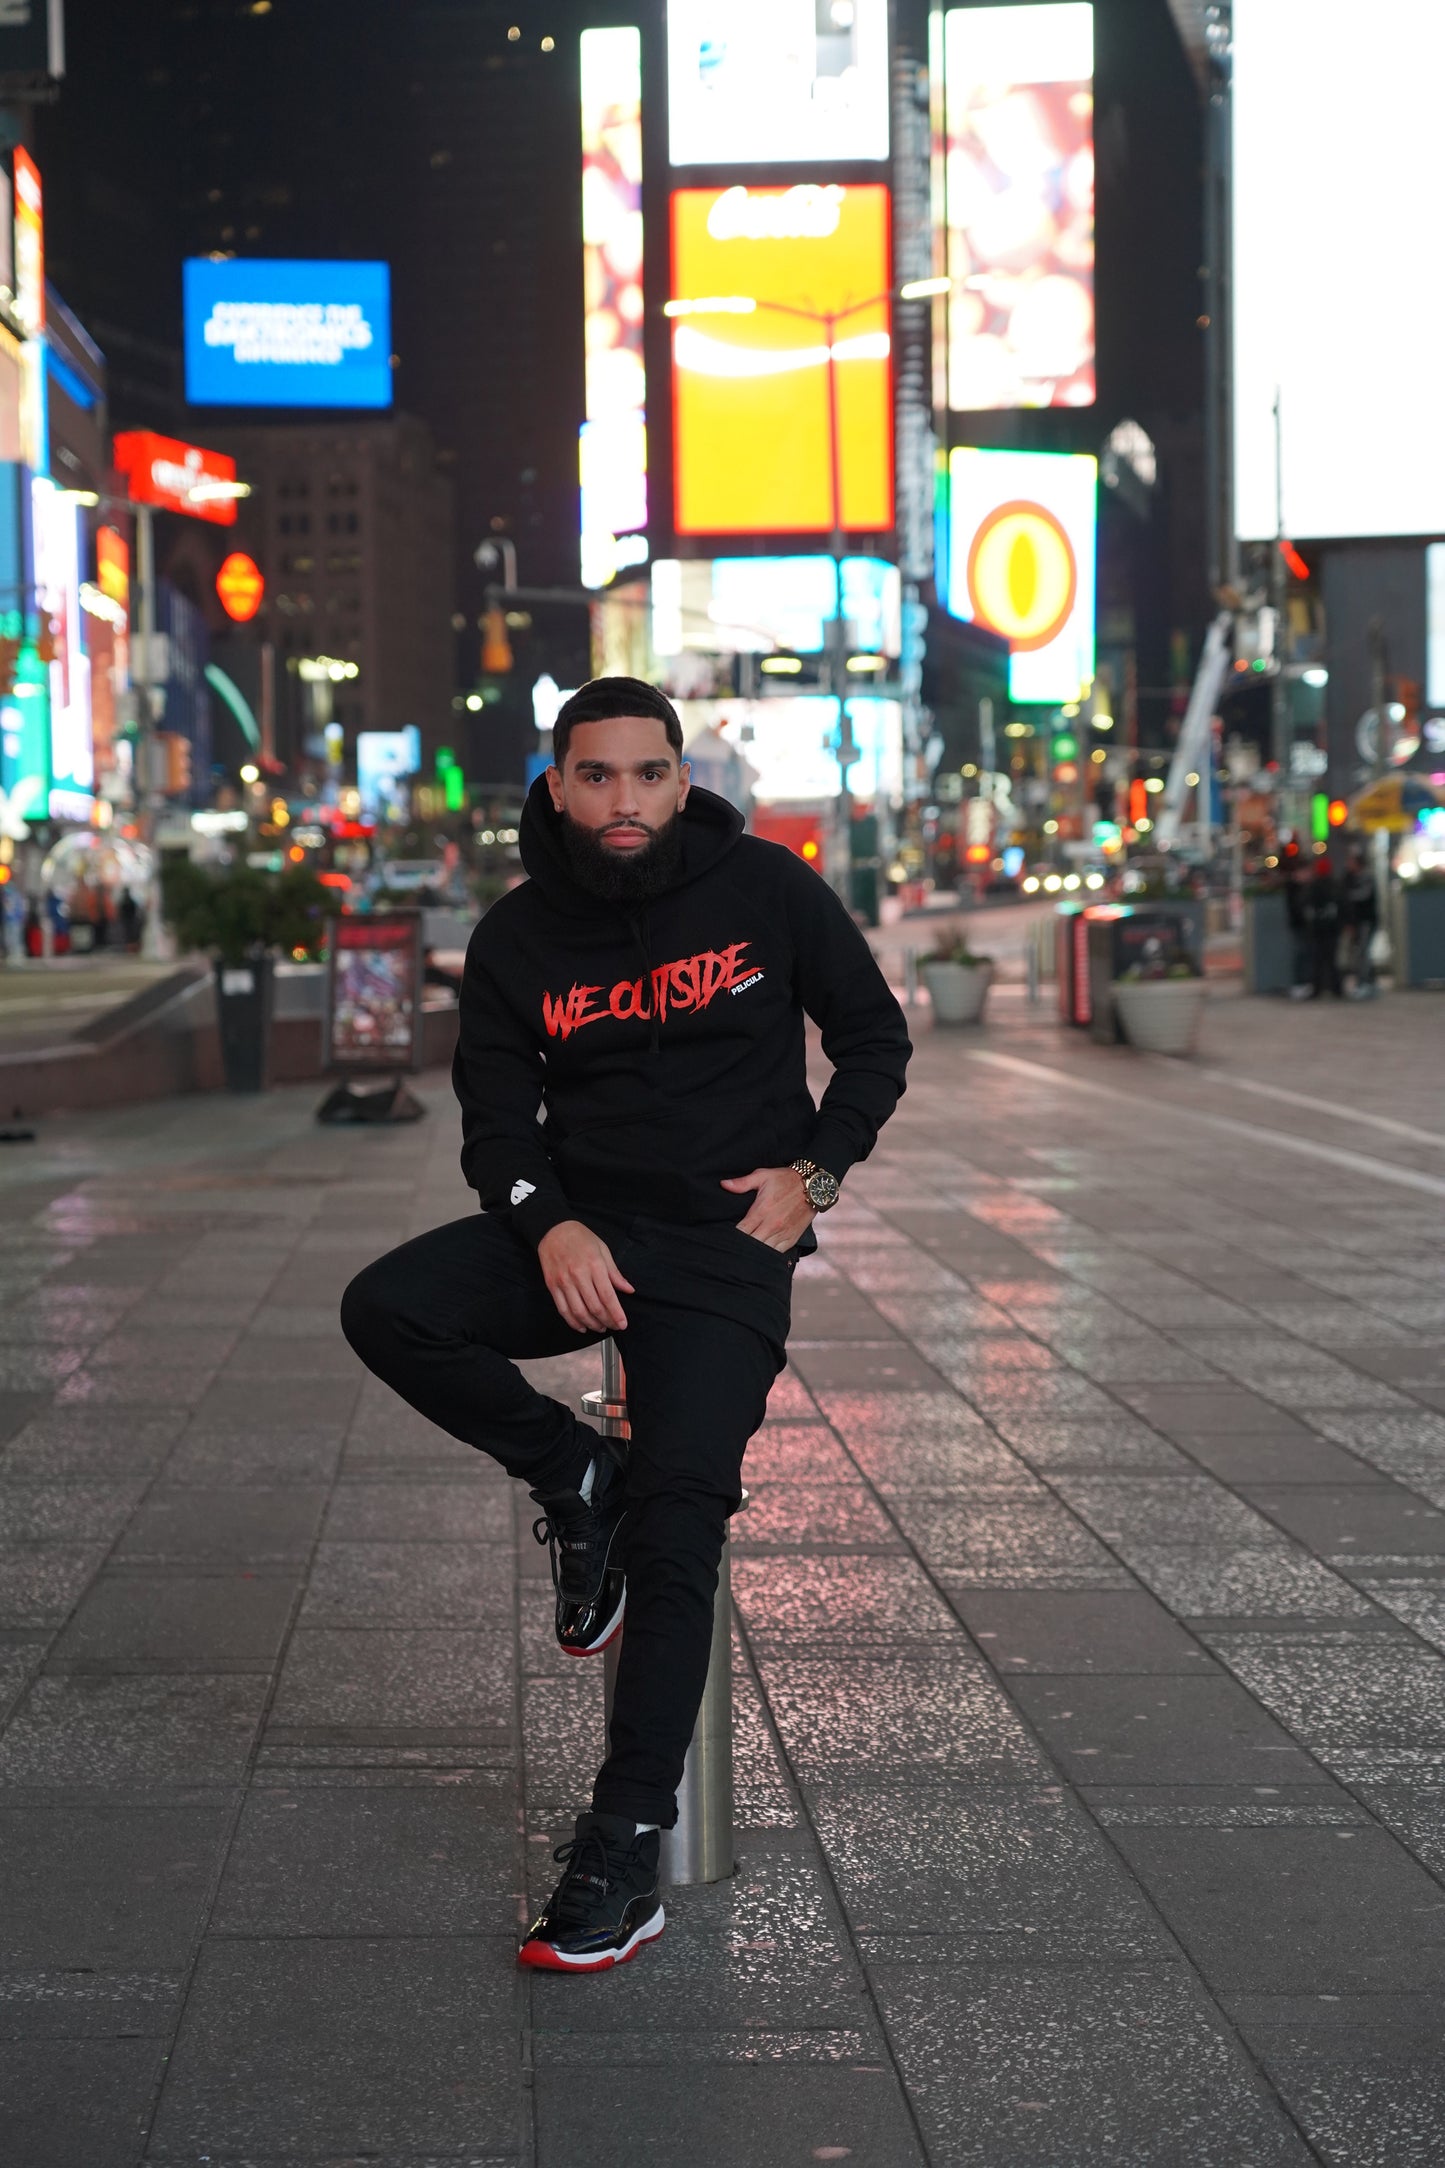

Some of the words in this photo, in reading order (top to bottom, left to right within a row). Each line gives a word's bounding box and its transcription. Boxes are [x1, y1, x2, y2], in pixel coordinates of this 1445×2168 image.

[542, 981, 612, 1042] WE
[609, 942, 766, 1024] OUTSIDE
[731, 972, 765, 996] PELICULA
